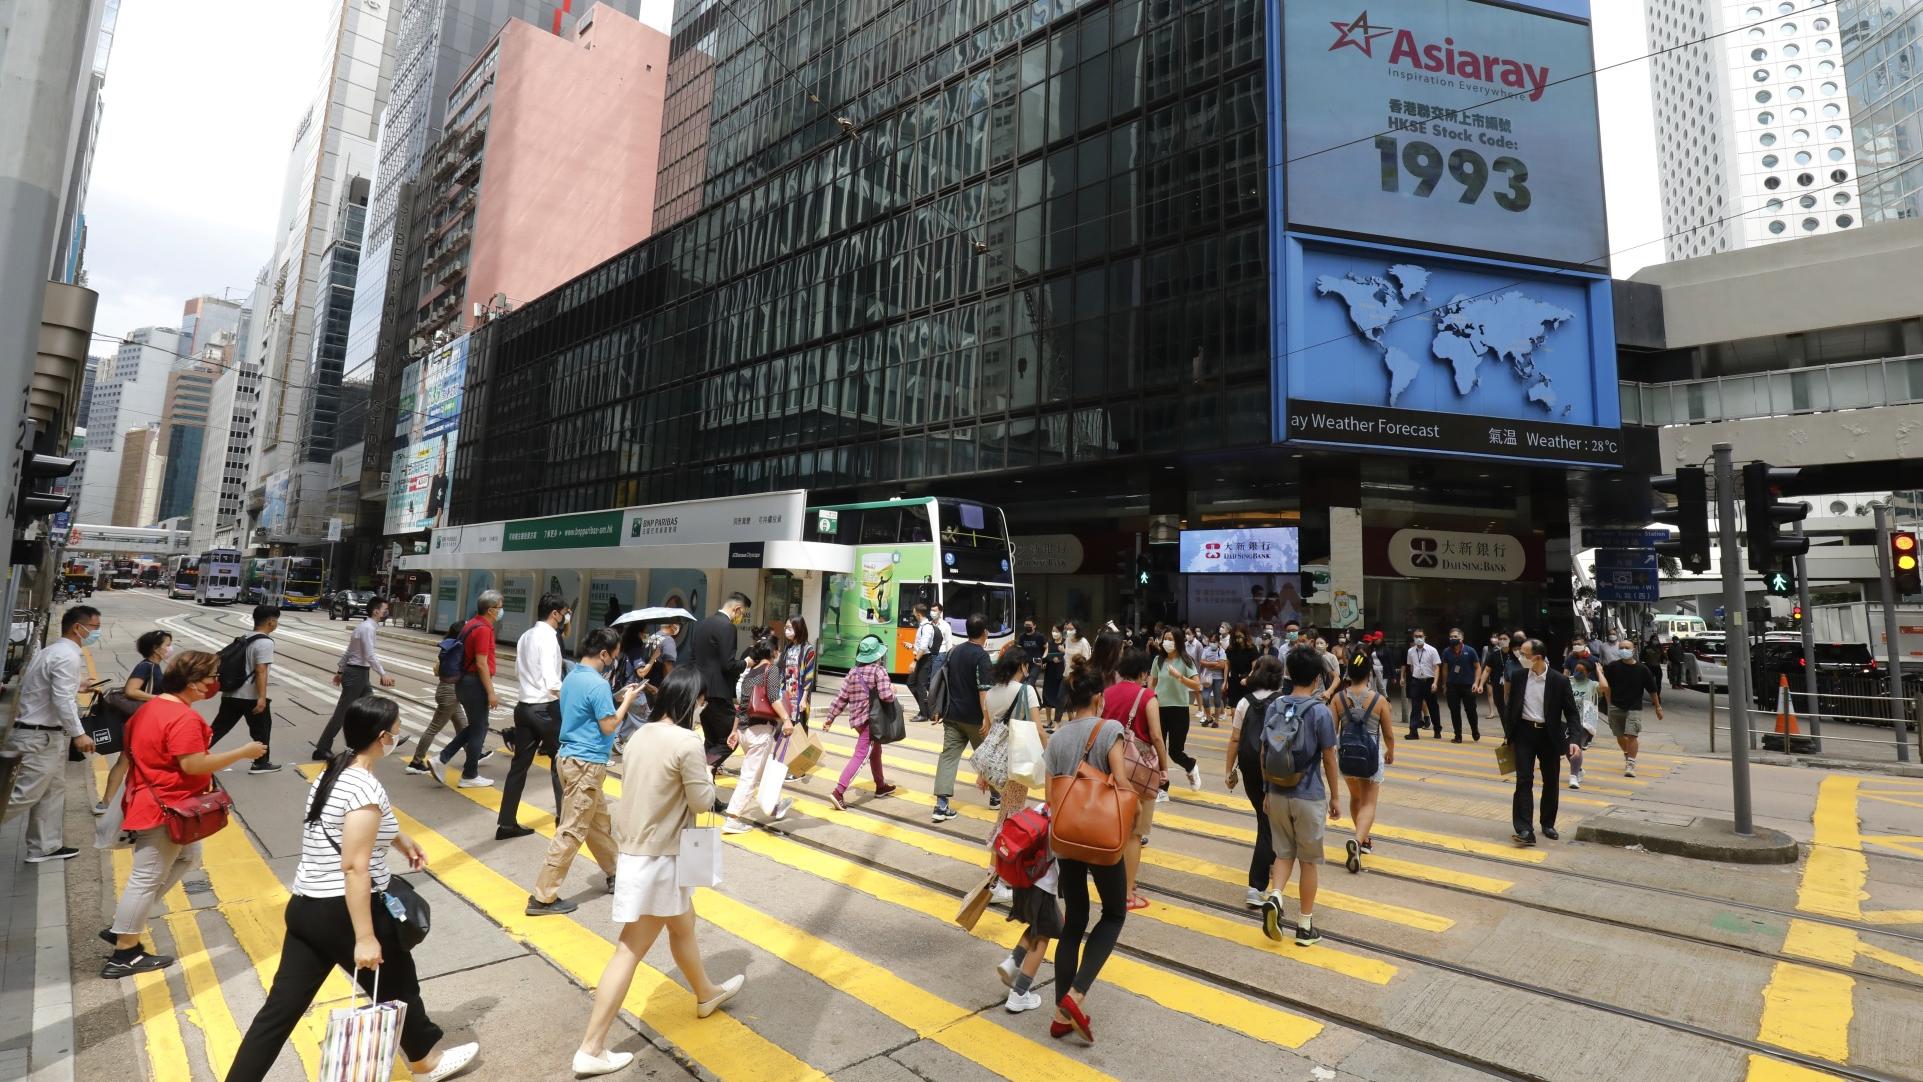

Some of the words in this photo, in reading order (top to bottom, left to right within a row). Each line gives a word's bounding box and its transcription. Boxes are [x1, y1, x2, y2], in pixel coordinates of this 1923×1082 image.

[1388, 29, 1550, 102] Asiaray
[1388, 67, 1454, 88] Inspiration
[1459, 82, 1527, 101] Everywhere
[1388, 98, 1512, 133] 香港聯交所上市編號
[1388, 115, 1427, 134] HKSE
[1432, 124, 1472, 143] Stock
[1478, 132, 1519, 151] Code:
[1374, 135, 1532, 213] 1993
[1311, 413, 1374, 432] Weather
[1378, 419, 1440, 438] Forecast
[1526, 432, 1581, 451] Weather
[1591, 440, 1618, 453] 28°C
[643, 519, 655, 528] BNP
[655, 516, 678, 526] PARIBAS
[1644, 529, 1666, 537] Station
[1224, 541, 1272, 550] 大新銀行
[1442, 540, 1506, 557] 大新銀行
[1484, 562, 1506, 572] BANK
